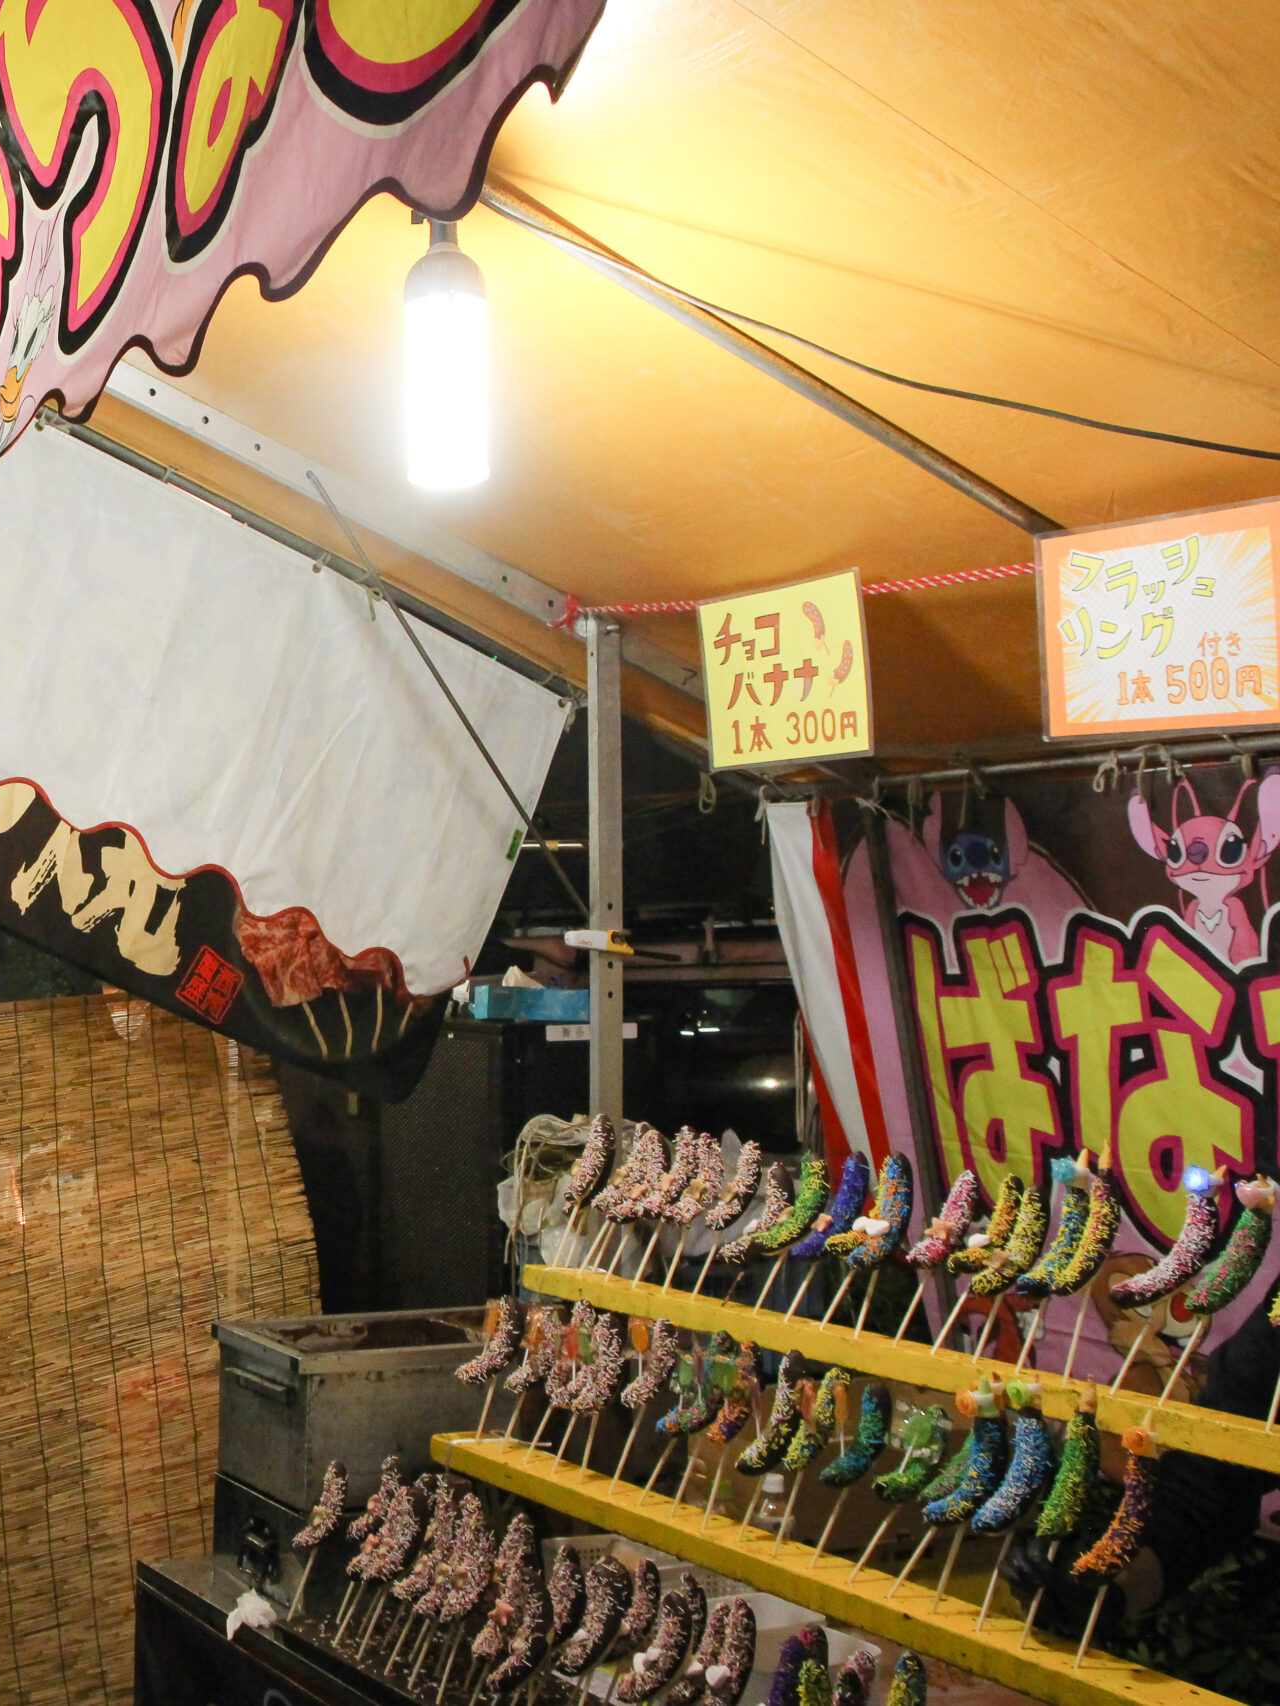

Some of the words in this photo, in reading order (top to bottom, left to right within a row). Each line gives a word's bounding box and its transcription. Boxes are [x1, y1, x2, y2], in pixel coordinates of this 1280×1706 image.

[1070, 535, 1216, 609] フラッシュ
[714, 611, 782, 666] チョコ
[1062, 605, 1175, 660] リング
[1197, 631, 1243, 657] 付き
[727, 657, 820, 711] バナナ
[1116, 670, 1155, 706] 1本
[1166, 656, 1263, 704] 500円
[731, 715, 773, 755] 1本
[785, 708, 859, 747] 300円
[906, 920, 1280, 1250] ばな
